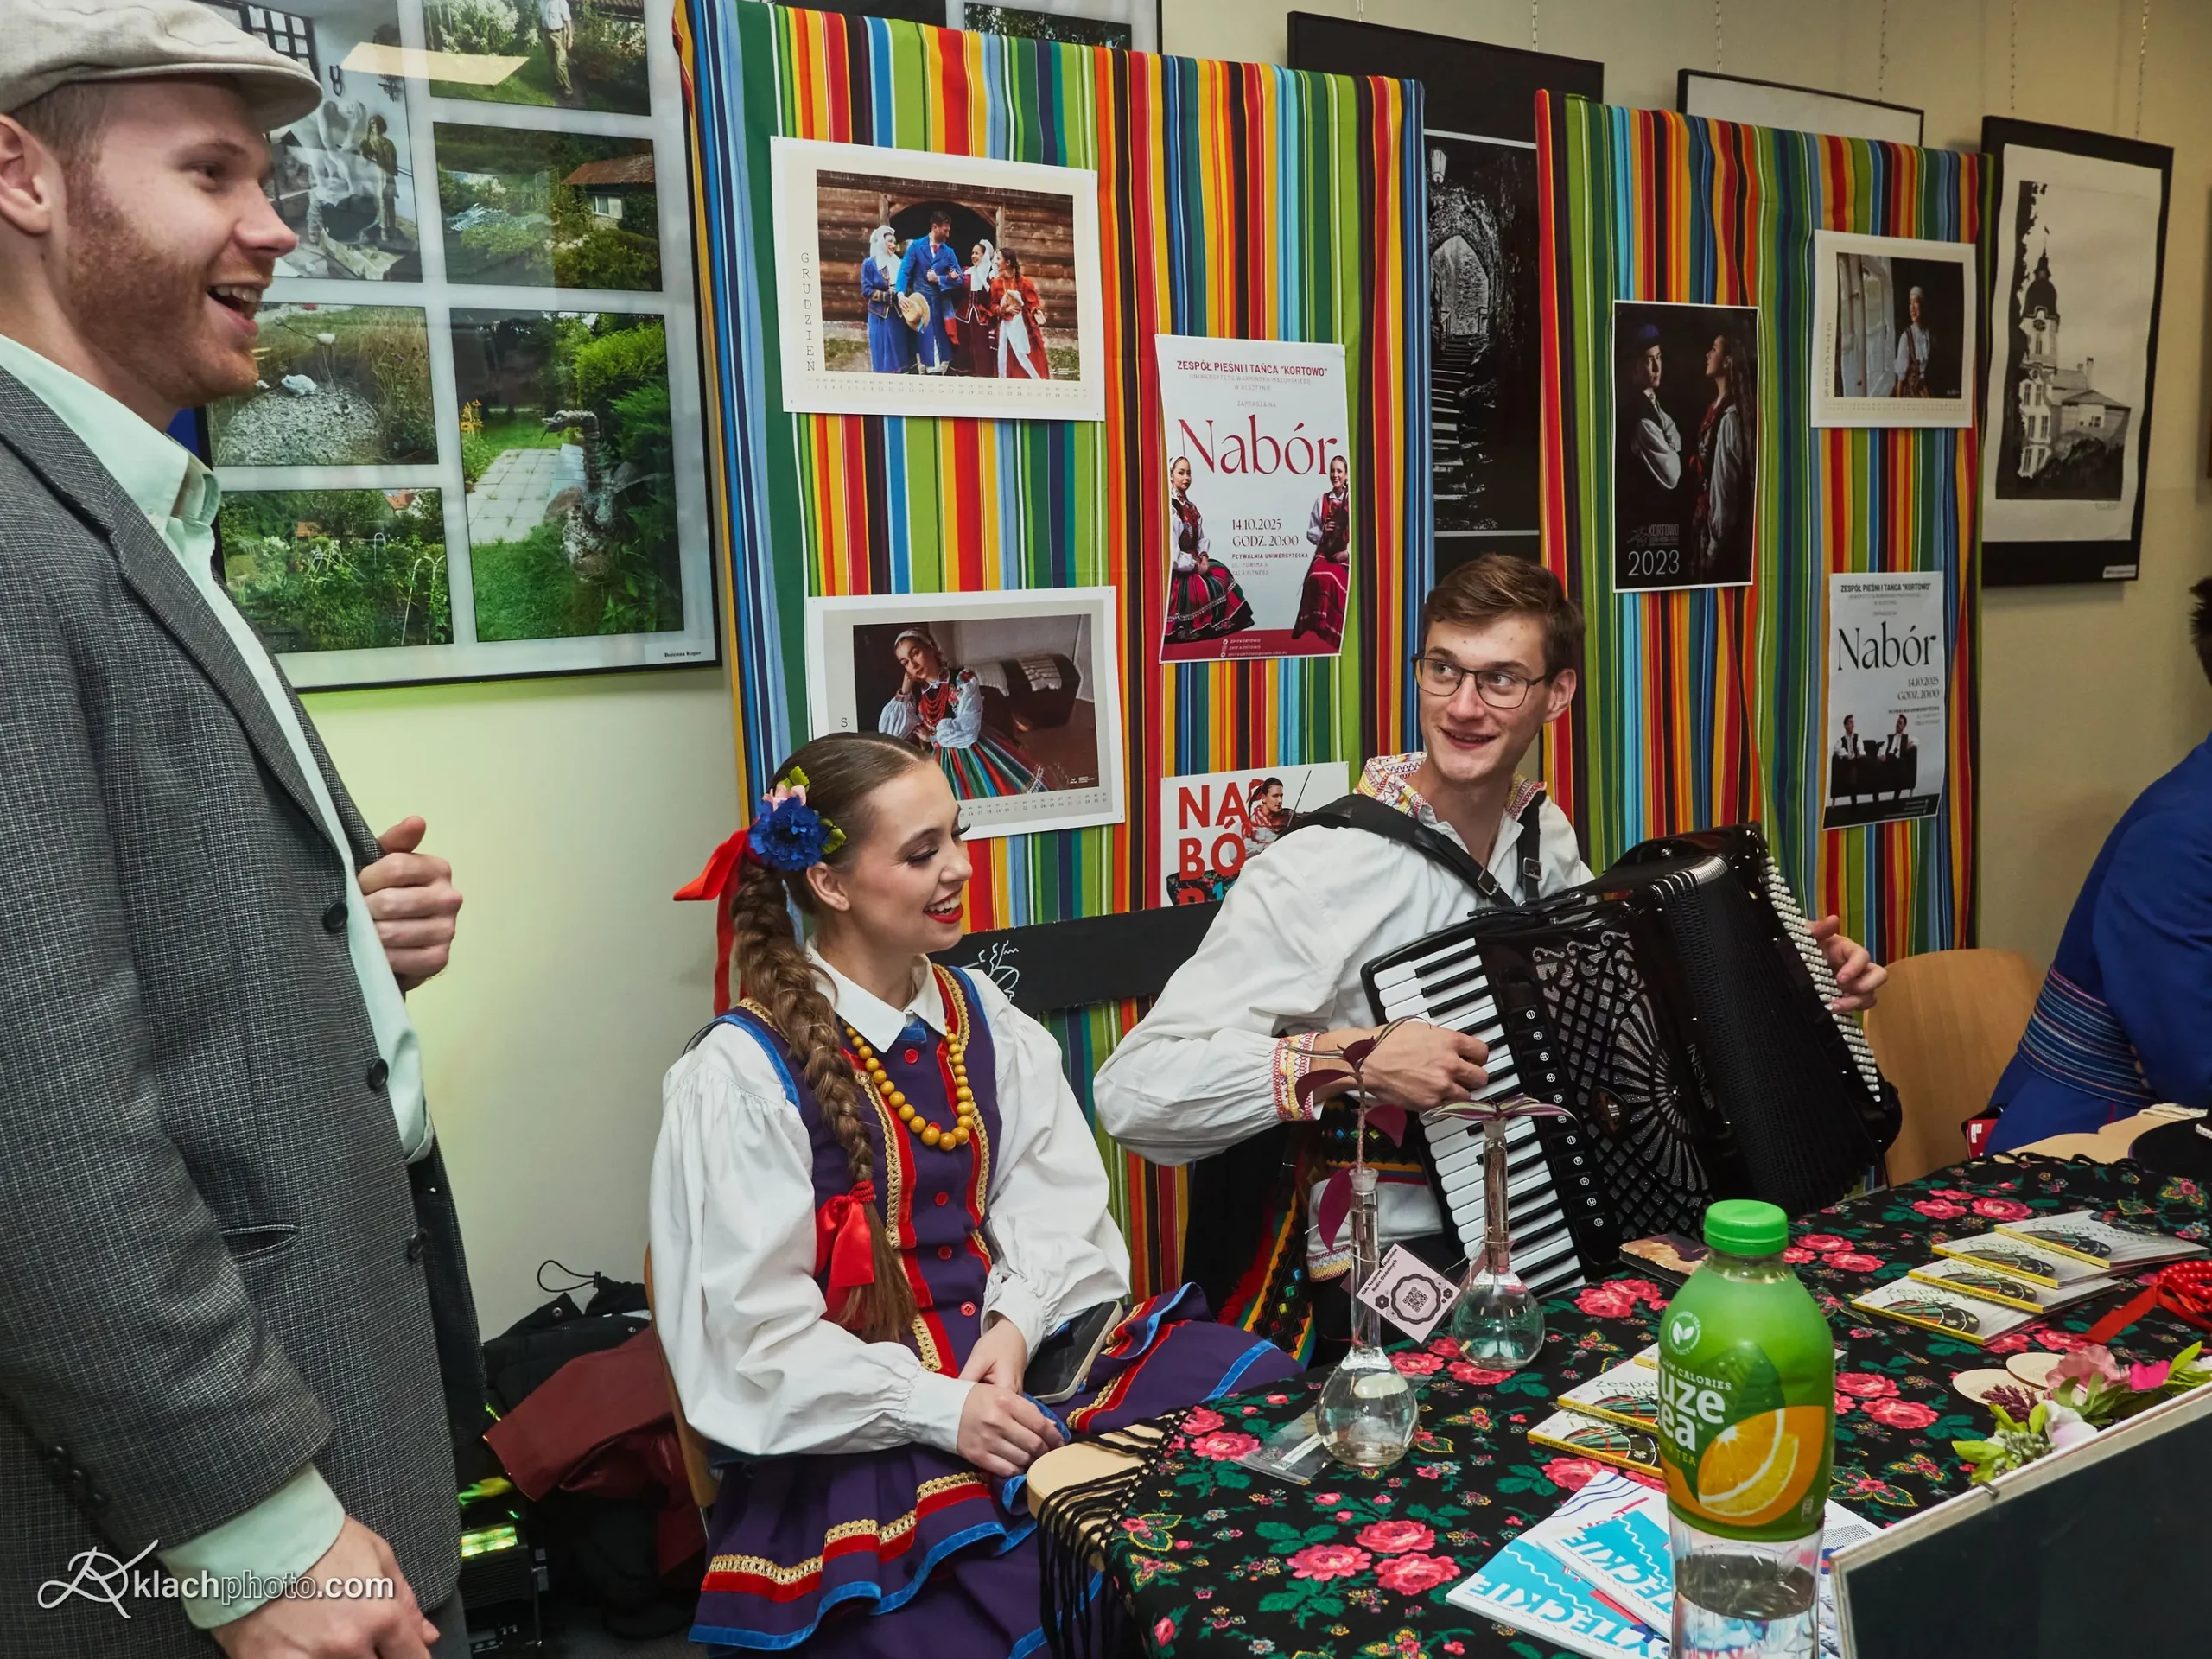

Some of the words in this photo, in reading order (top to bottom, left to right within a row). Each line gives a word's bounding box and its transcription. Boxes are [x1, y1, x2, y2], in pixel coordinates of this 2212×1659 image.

[800, 252, 815, 372] GRUDZIEŃ
[1177, 359, 1213, 372] ZESPÓŁ
[1215, 361, 1243, 372] PIEŚNI
[1249, 363, 1278, 374] TAŃCA
[1281, 365, 1327, 376] "KORTOWO"
[1178, 414, 1338, 475] Nabór
[1232, 518, 1281, 531] 14.10.2025
[1649, 524, 1679, 536] KORTOWO
[1232, 536, 1267, 547] GODZ.
[1269, 535, 1299, 547] 20:00
[1628, 550, 1679, 575] 2023
[1837, 620, 1937, 671] Nabór
[1179, 782, 1249, 830] NA
[1612, 1388, 1658, 1396] Tańc
[1678, 1368, 1732, 1391] CALORIES
[1659, 1367, 1726, 1424] uze
[1659, 1403, 1695, 1452] ea
[1676, 1449, 1696, 1466] TEA
[1561, 1535, 1672, 1614] TECKIE
